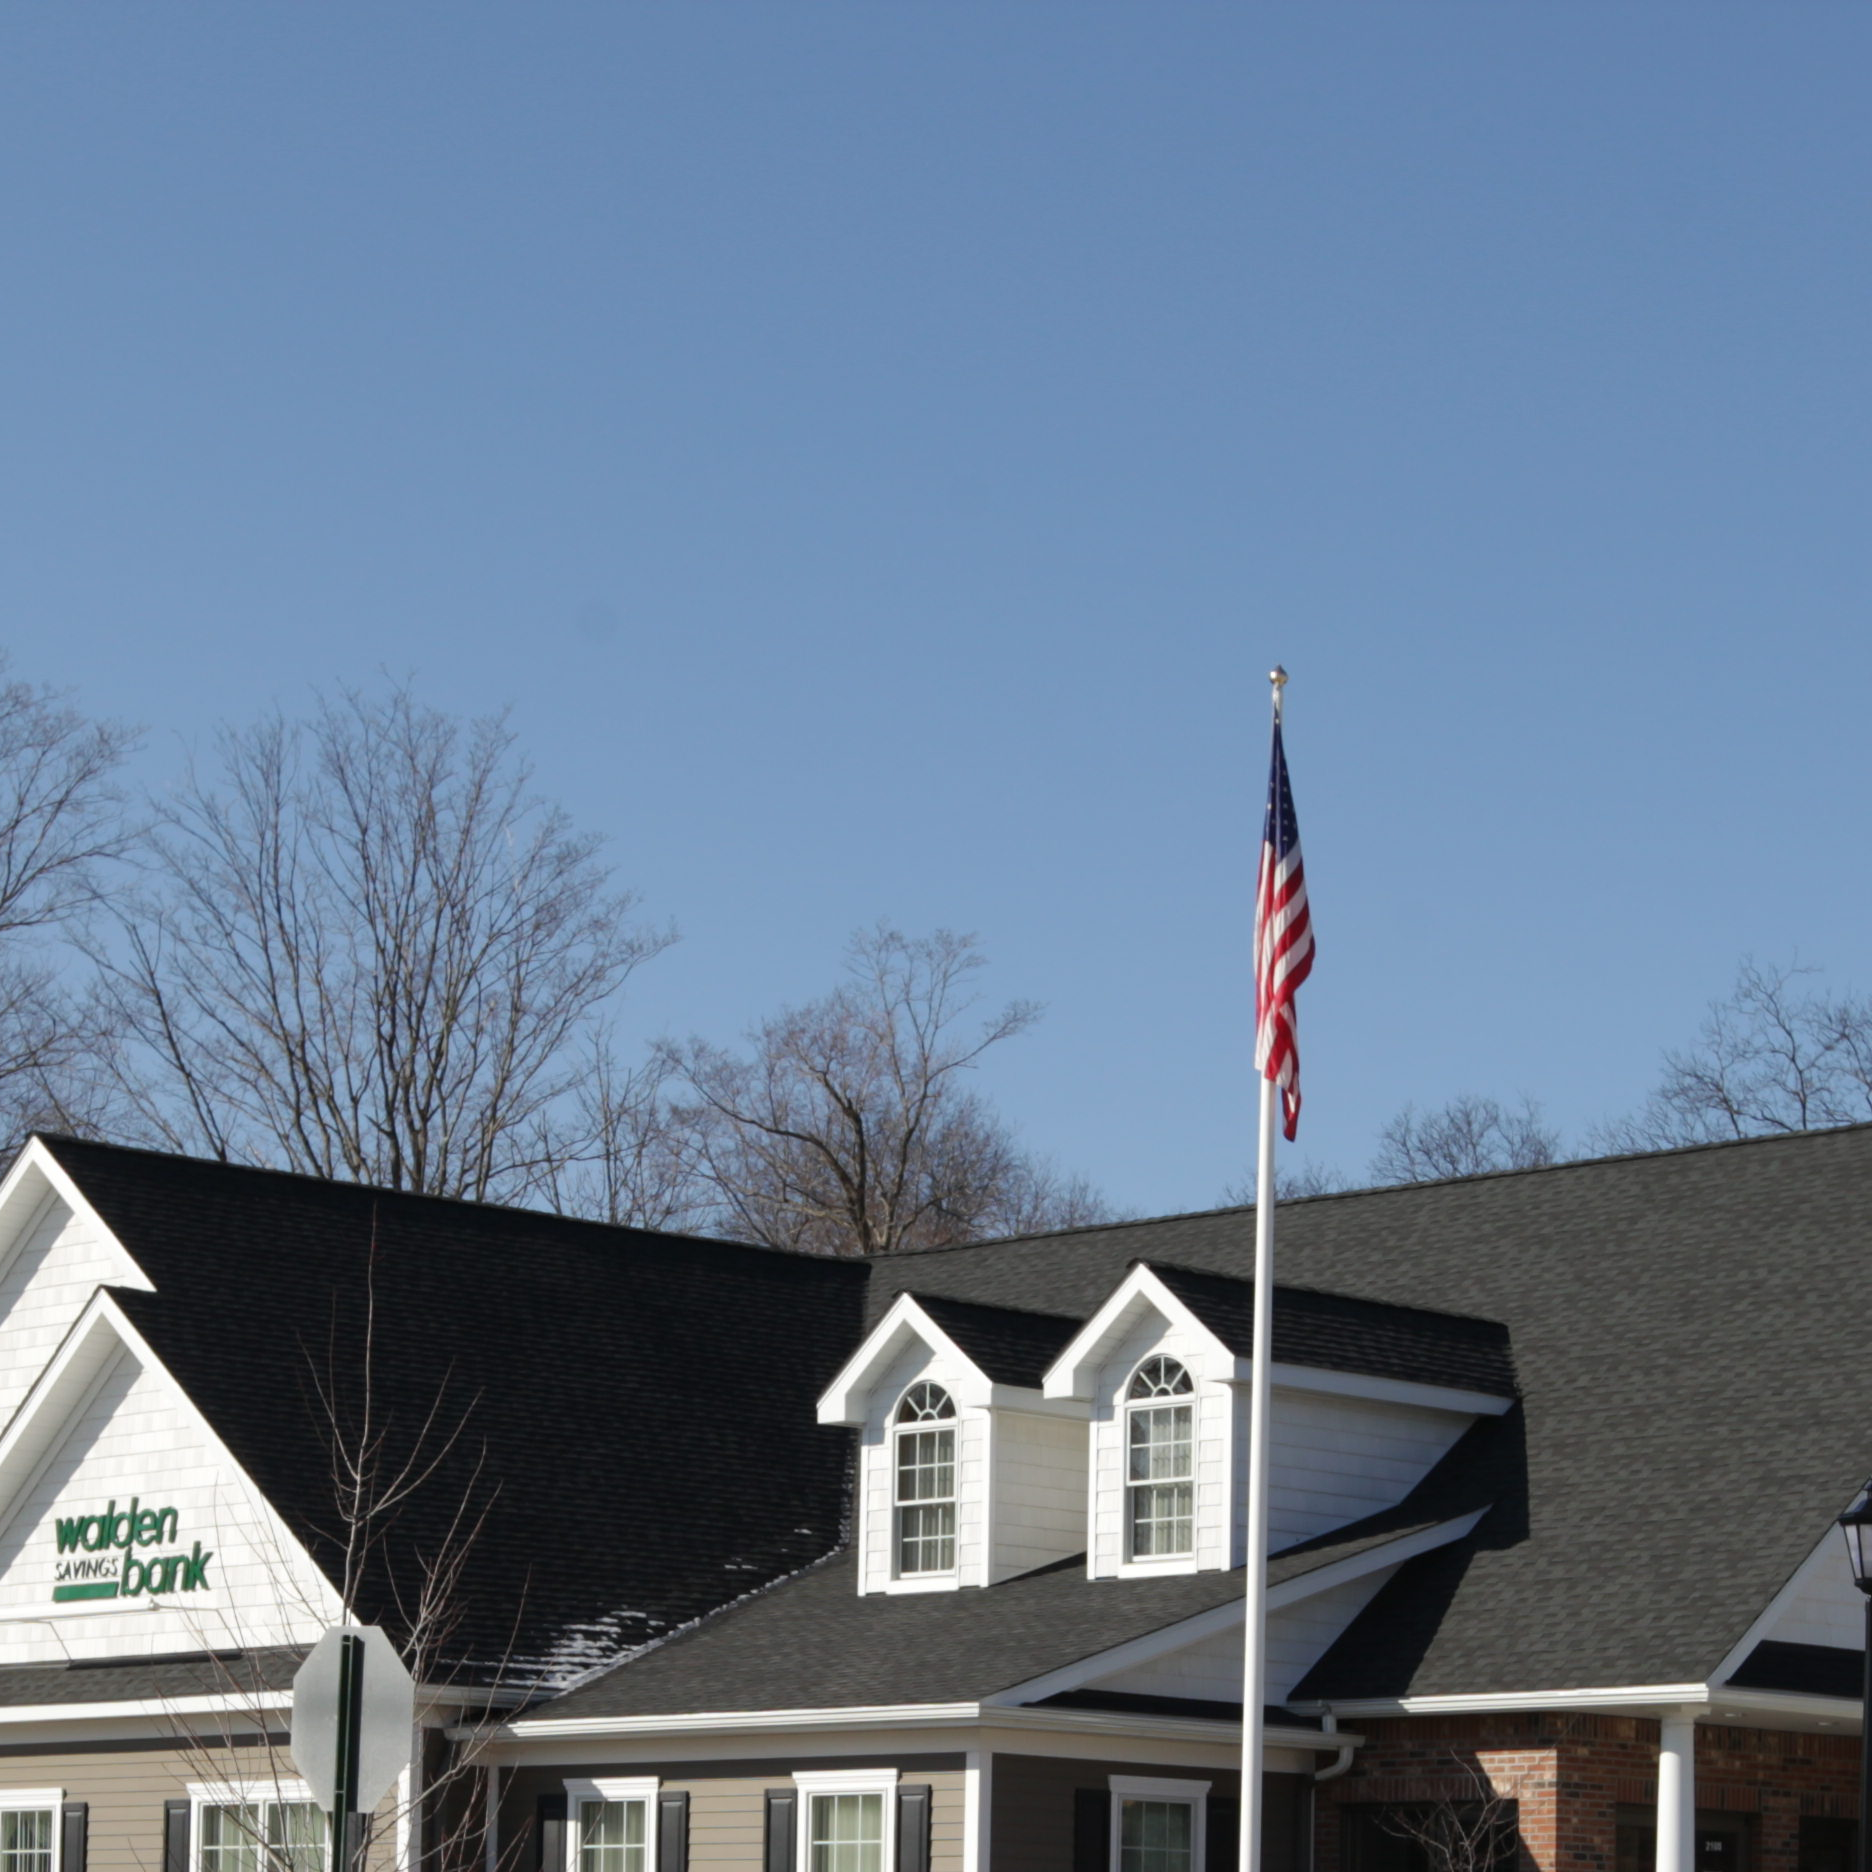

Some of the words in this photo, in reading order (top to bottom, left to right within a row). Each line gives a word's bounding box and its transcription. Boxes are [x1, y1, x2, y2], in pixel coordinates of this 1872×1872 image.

[55, 1497, 178, 1555] walden
[55, 1558, 119, 1581] SAVINGS
[120, 1541, 213, 1597] bank
